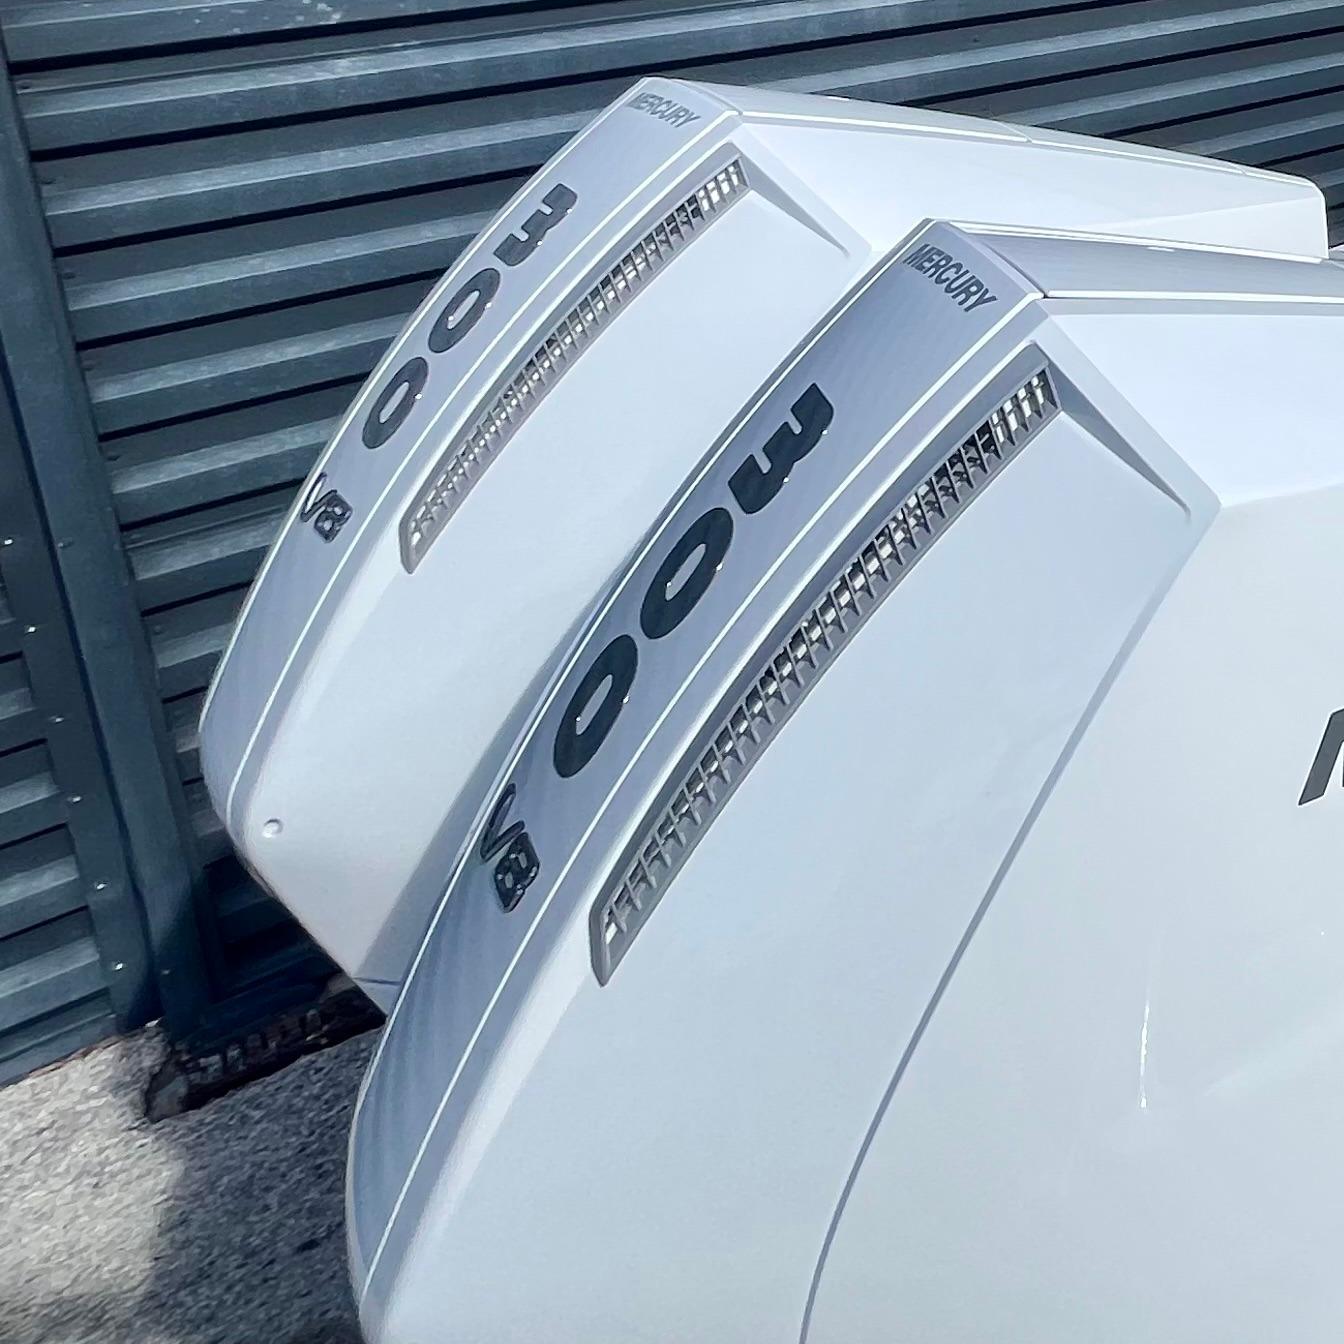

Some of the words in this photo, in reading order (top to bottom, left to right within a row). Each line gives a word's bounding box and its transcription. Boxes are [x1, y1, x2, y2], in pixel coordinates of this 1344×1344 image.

[629, 92, 701, 129] MERCURY
[362, 183, 578, 449] 300
[903, 243, 998, 313] MERCURY
[301, 472, 353, 543] V8
[552, 382, 835, 779] 300
[480, 783, 540, 913] V8
